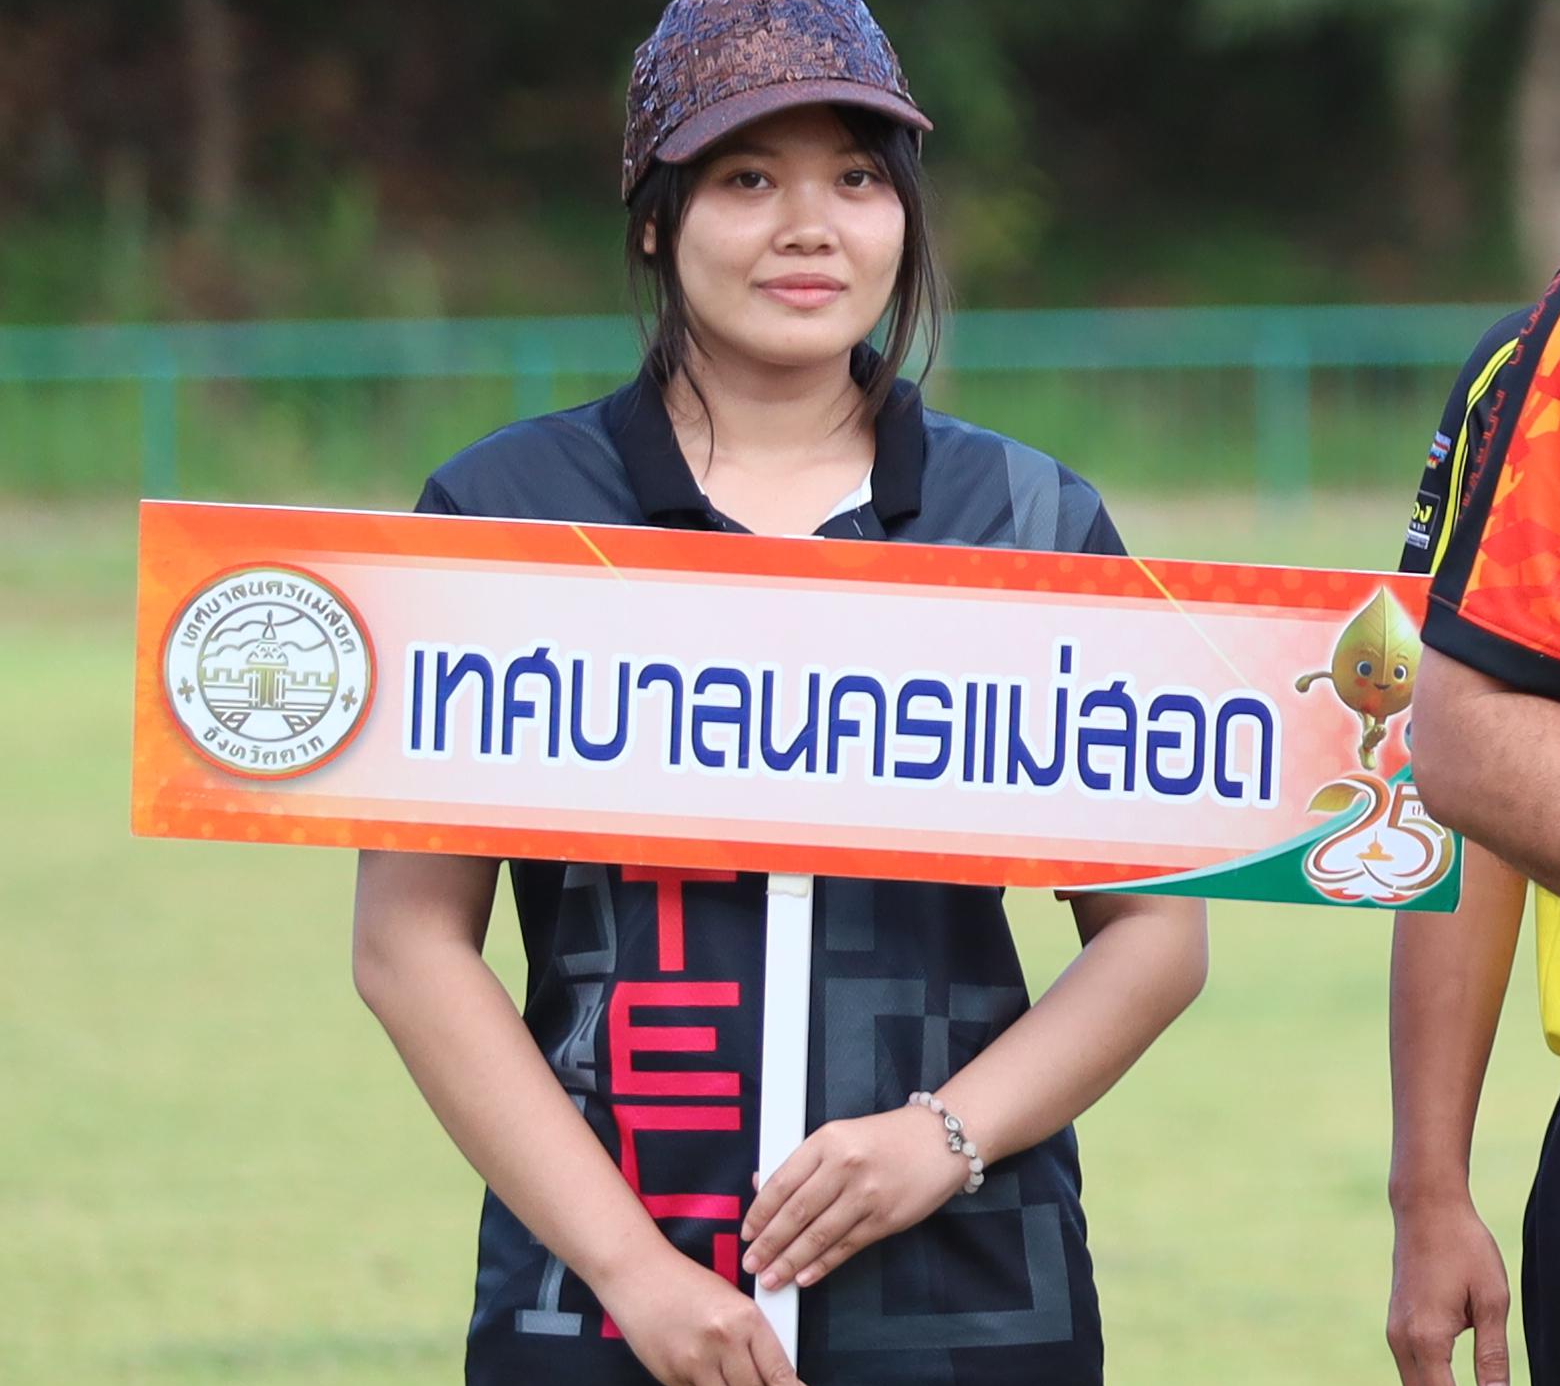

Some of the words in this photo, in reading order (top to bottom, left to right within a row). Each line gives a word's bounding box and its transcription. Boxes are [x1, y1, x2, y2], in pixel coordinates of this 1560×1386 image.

[180, 580, 357, 655] เทศบาลนครแม่สอด
[203, 726, 325, 765] จังหวัดตาก
[410, 644, 1276, 800] เทศบาลนครแม่สอด
